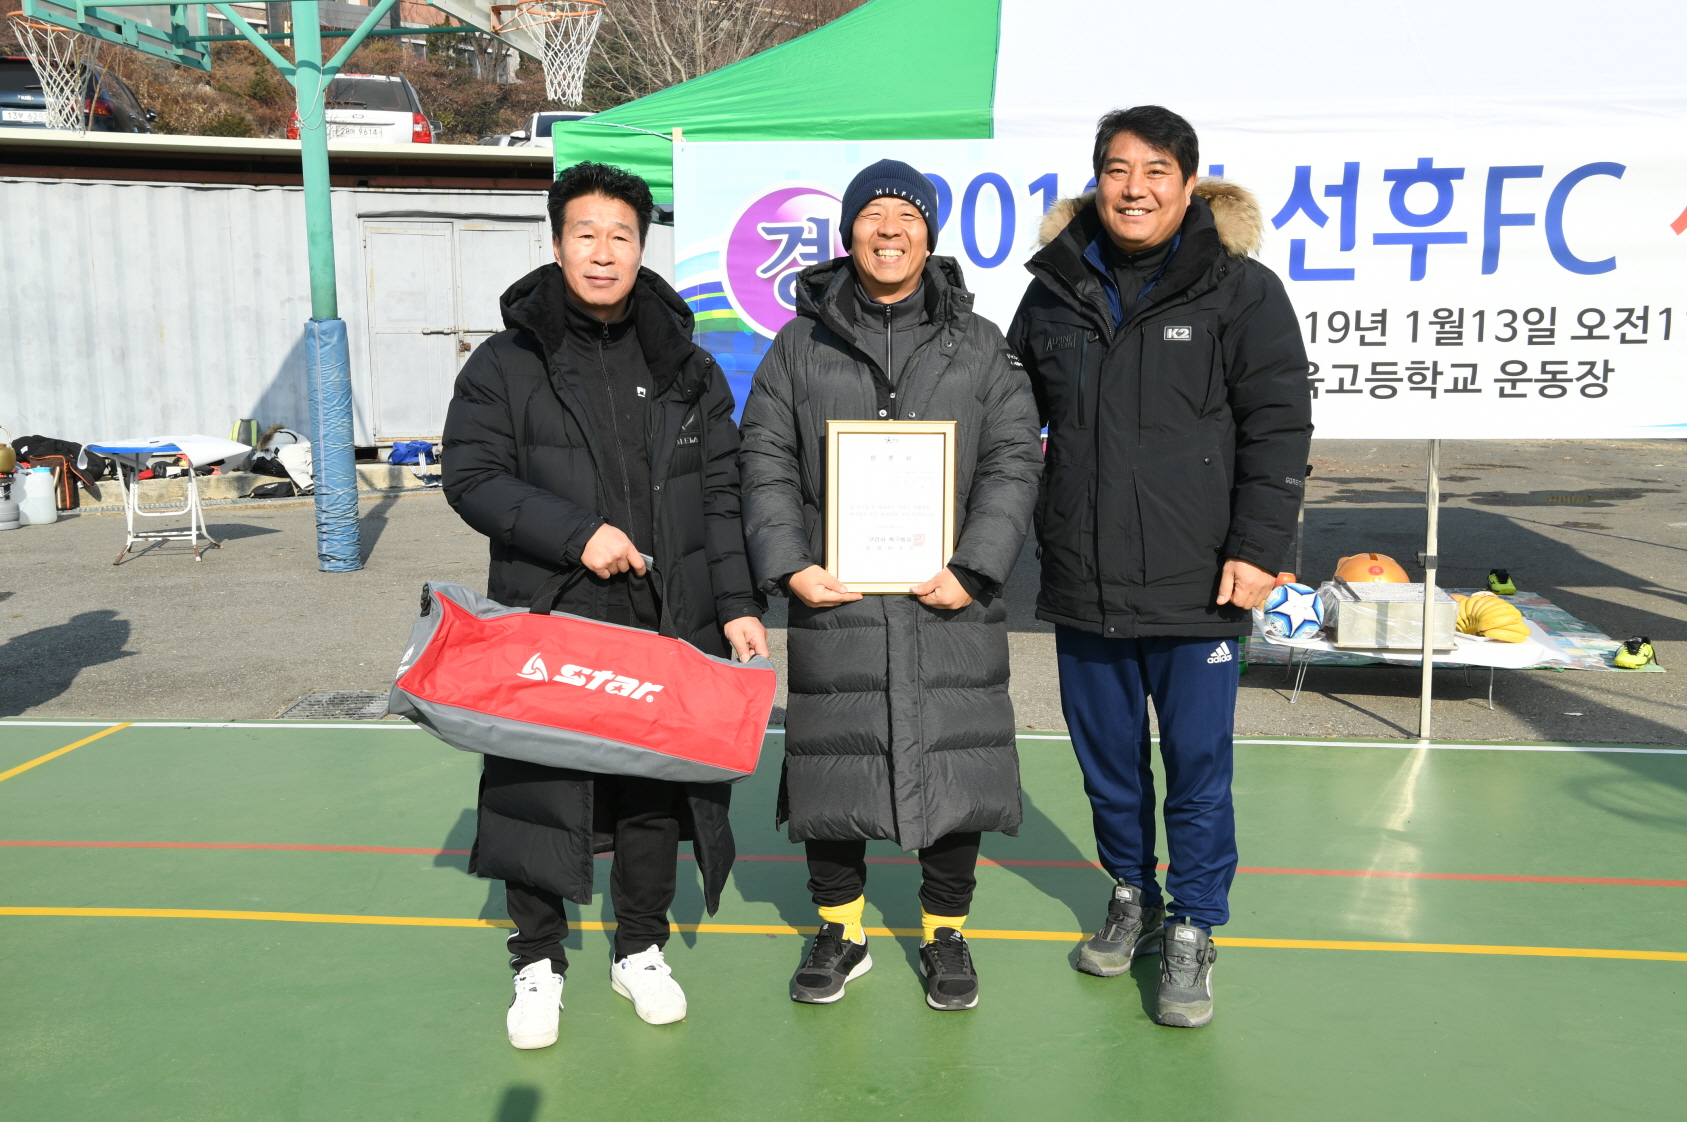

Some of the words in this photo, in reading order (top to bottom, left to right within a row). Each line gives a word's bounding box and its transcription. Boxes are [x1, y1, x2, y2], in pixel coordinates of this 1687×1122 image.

[1271, 157, 1627, 281] 선후FC
[1046, 333, 1074, 351] ALPINE
[1166, 328, 1190, 338] K2
[1305, 308, 1388, 346] 19년
[1570, 305, 1687, 344] 오전1
[1493, 359, 1615, 399] 운동장
[1207, 653, 1232, 664] adidas
[552, 664, 664, 700] star
